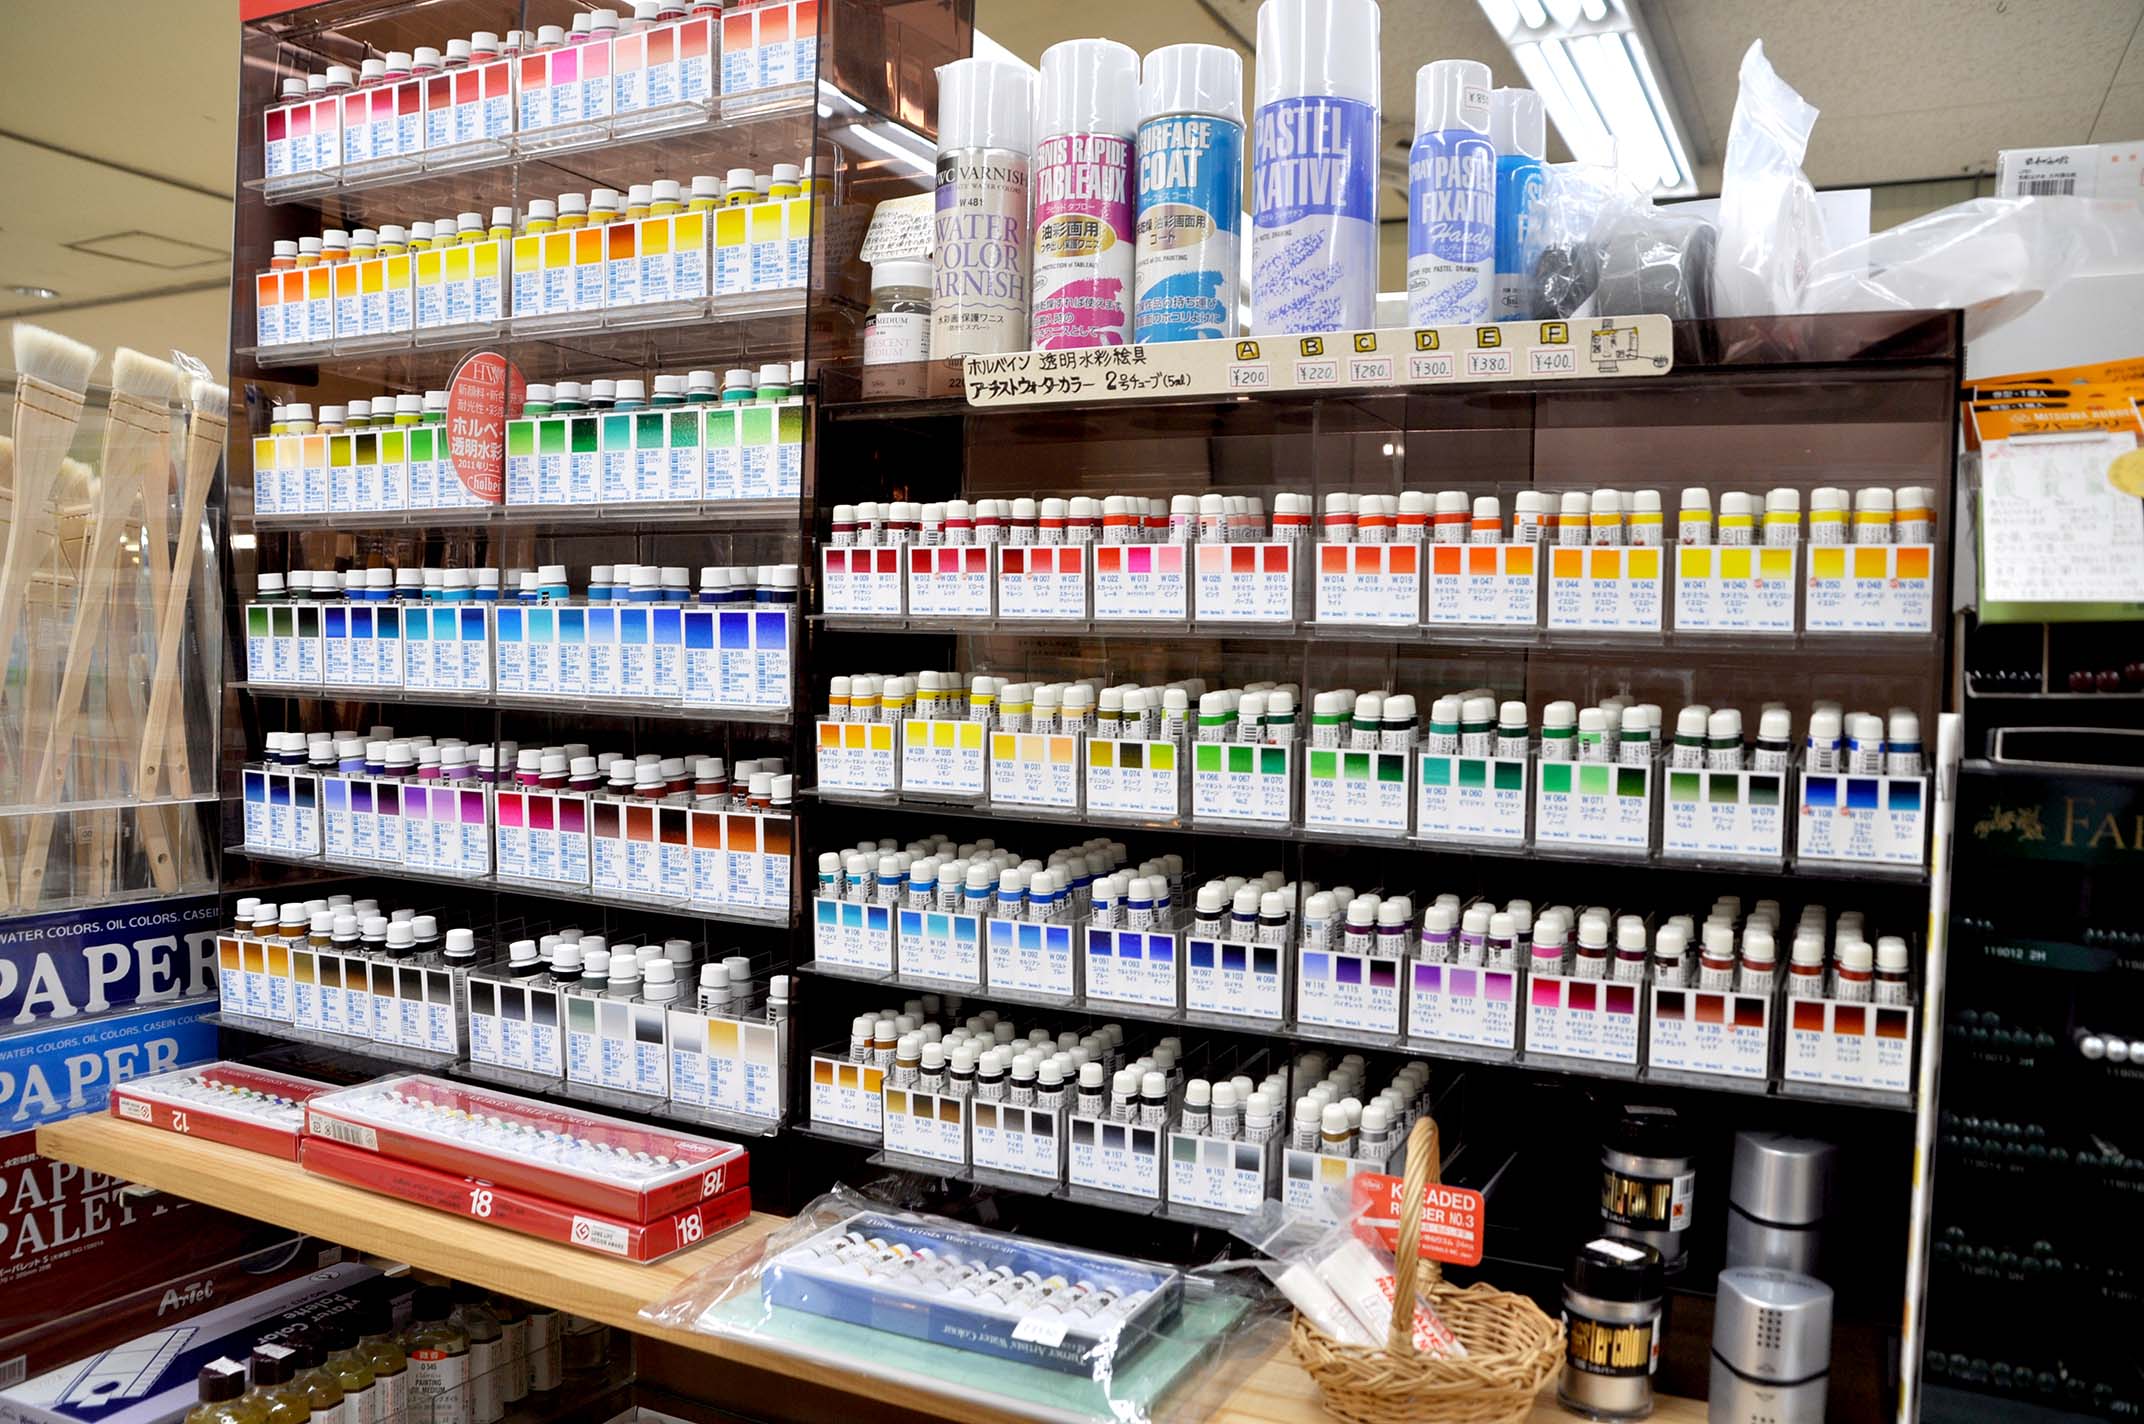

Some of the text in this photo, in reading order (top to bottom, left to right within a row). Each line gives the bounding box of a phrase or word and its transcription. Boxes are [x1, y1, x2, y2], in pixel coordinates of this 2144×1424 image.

[1138, 120, 1212, 153] SURFACE
[1256, 106, 1349, 162] PASTEL
[1073, 137, 1127, 168] RAPIDE
[1038, 164, 1126, 206] TABLEAUX
[1139, 150, 1204, 195] COAT
[959, 197, 983, 208] W 481
[936, 214, 1020, 246] WATER
[1041, 221, 1099, 241] 油彩画用
[1150, 231, 1176, 247] コート
[1429, 224, 1492, 250] Handy
[935, 241, 1021, 274] COLOR
[968, 347, 1147, 376] ホルベイン 透明水彩絵具
[453, 417, 504, 438] ホルベ
[451, 436, 504, 461] 透明水彩
[47, 922, 104, 938] COLORS.
[106, 920, 126, 931] OIL
[129, 914, 181, 928] COLORS.
[36, 1038, 81, 1053] COLORS.
[82, 1034, 98, 1044] OIL
[100, 1027, 141, 1041] COLORS.
[144, 1019, 176, 1032] CASEIN
[171, 1110, 190, 1133] 12
[702, 1170, 724, 1196] 18
[469, 1188, 494, 1218] 18
[1391, 1182, 1476, 1212] KEADED
[1390, 1202, 1475, 1228] RBER NO.3
[678, 1214, 701, 1244] 18
[283, 1294, 349, 1321] Palette
[257, 1322, 309, 1345] Color
[942, 1324, 977, 1342] Colour
[978, 1333, 1009, 1350] Water
[1049, 1348, 1087, 1366] Turner
